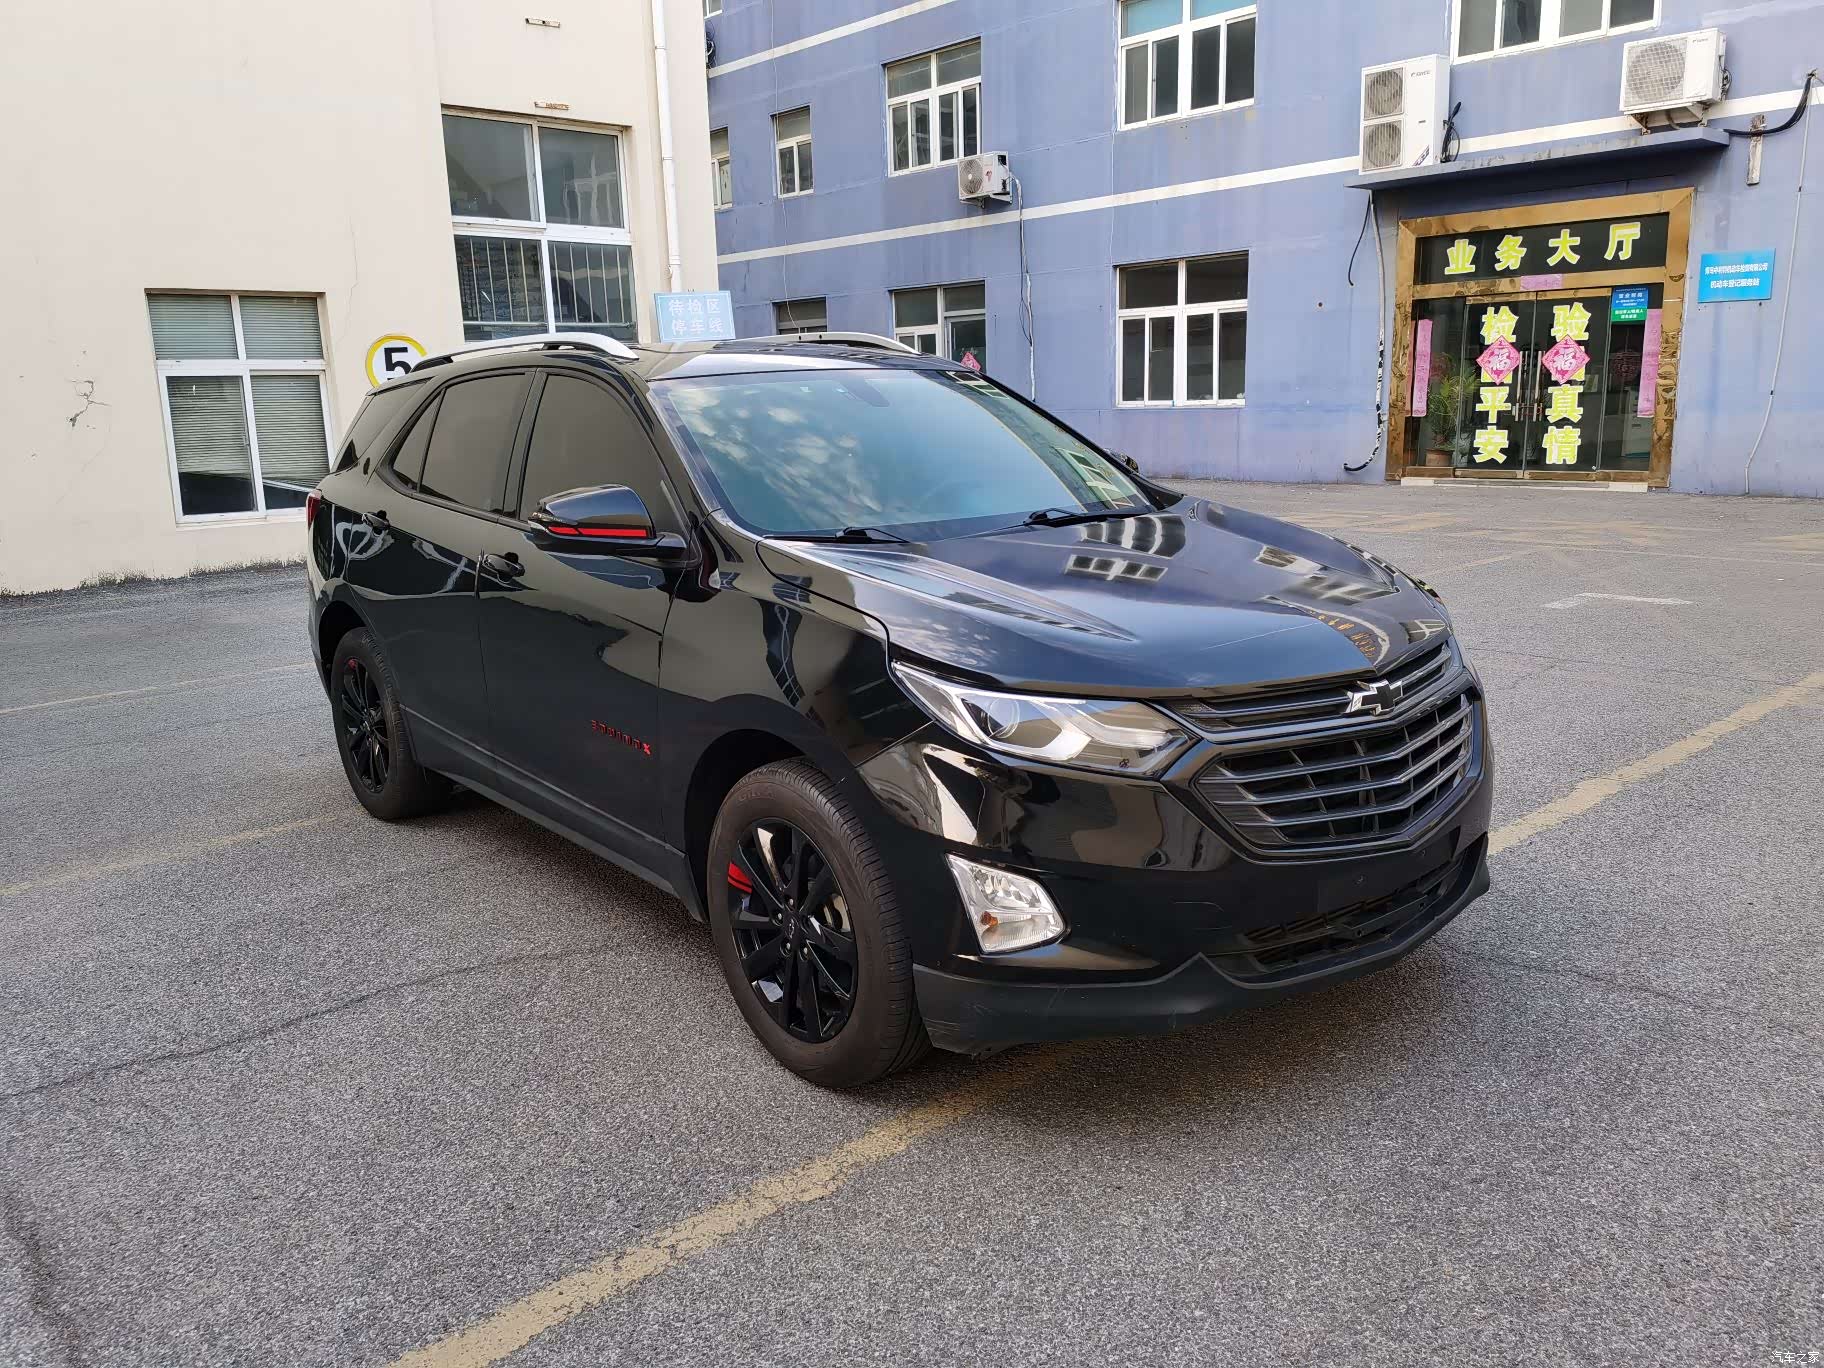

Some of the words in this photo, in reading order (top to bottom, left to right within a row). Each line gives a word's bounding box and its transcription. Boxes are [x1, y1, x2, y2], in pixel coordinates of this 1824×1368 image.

[1444, 222, 1641, 275] 业务大厅
[668, 298, 721, 317] 待检区
[384, 346, 412, 381] 5
[1490, 349, 1512, 371] 福
[1554, 349, 1577, 371] 福
[1473, 305, 1520, 464] 检平安
[1542, 301, 1591, 464] 验真情
